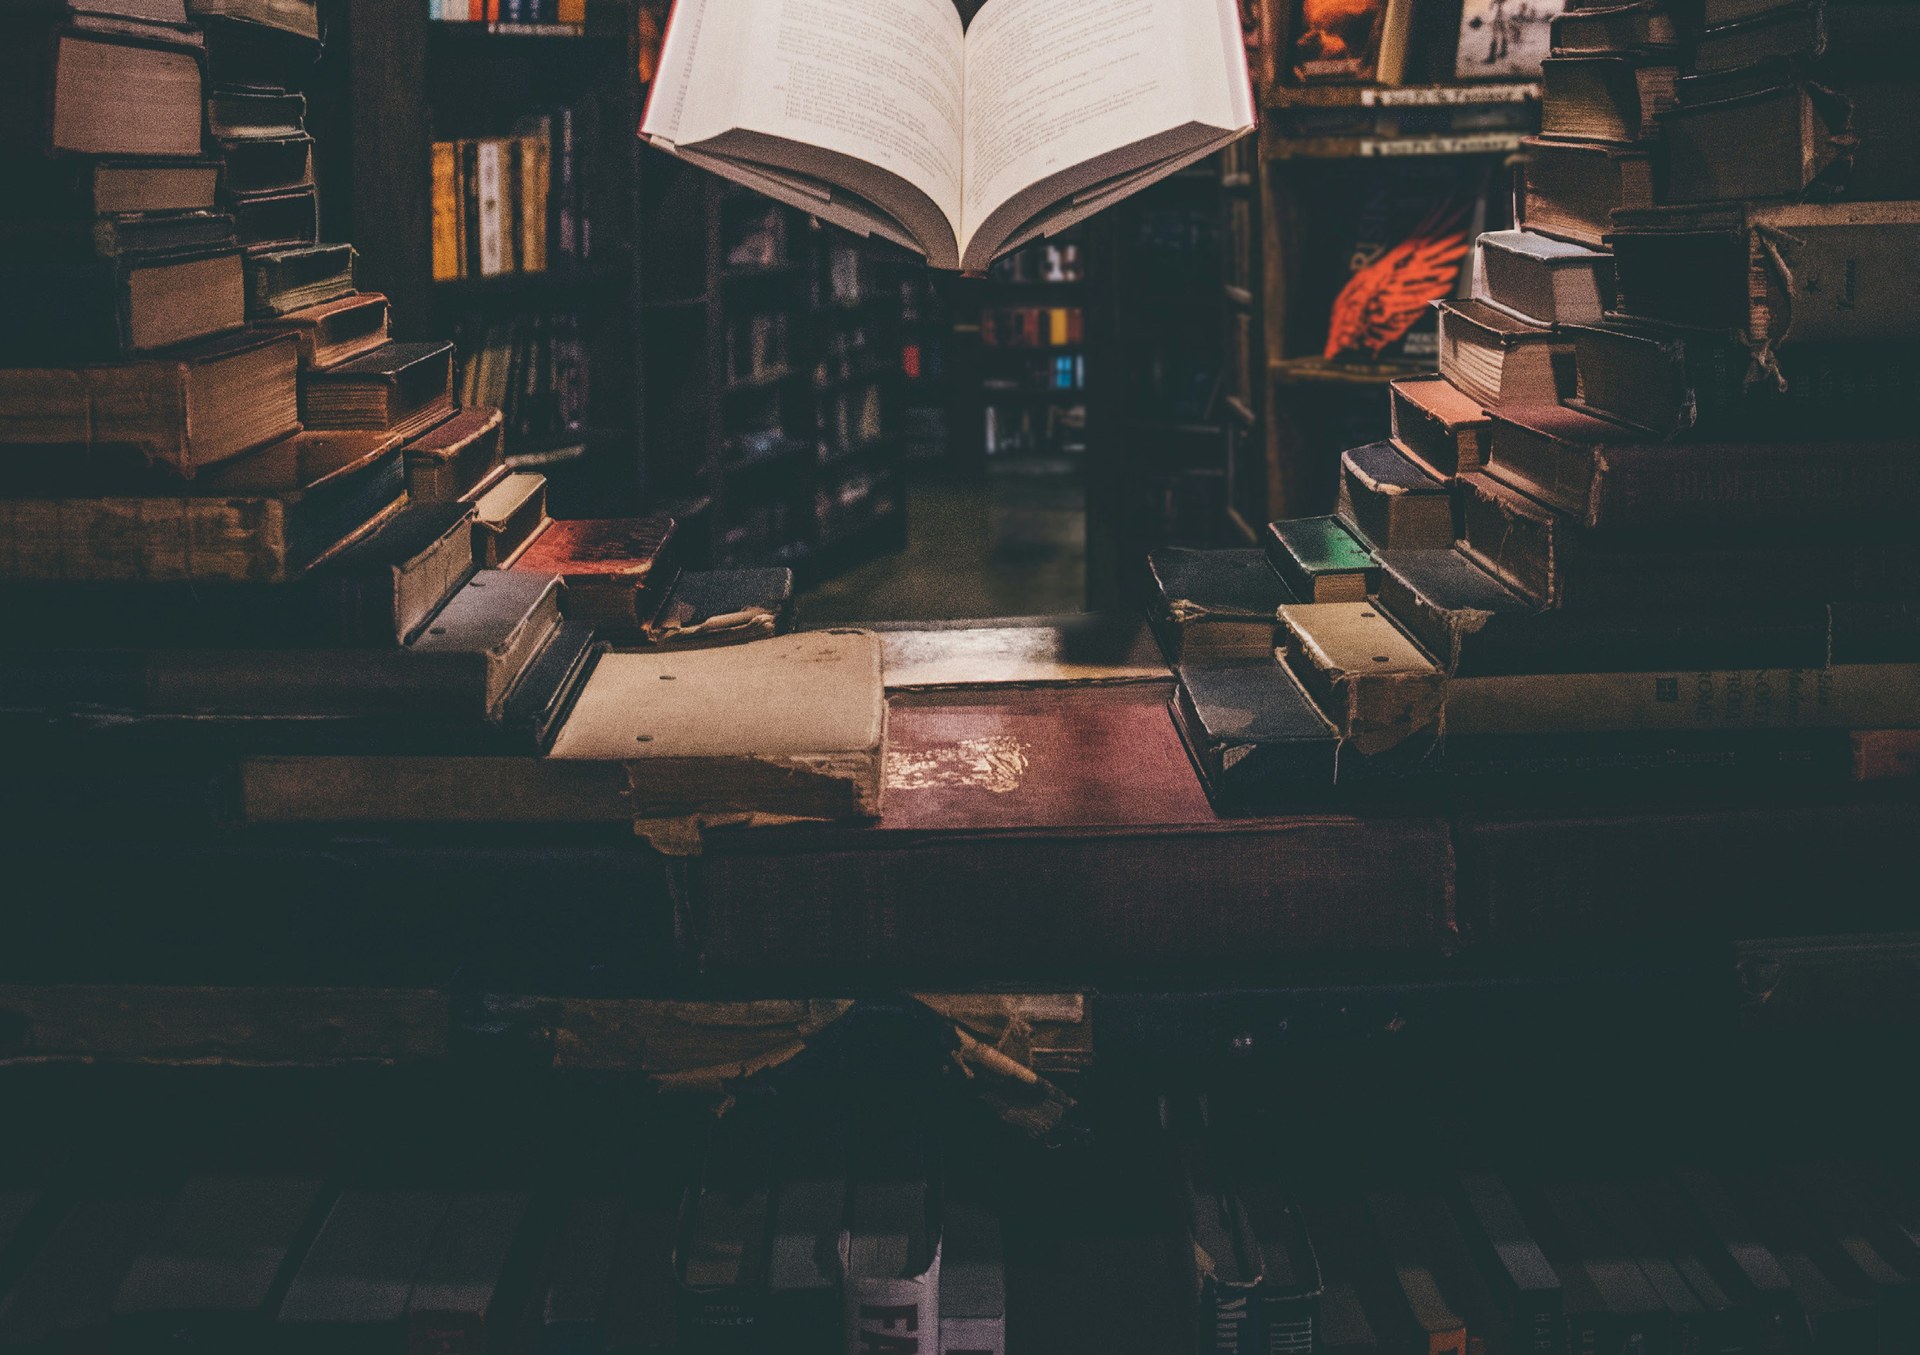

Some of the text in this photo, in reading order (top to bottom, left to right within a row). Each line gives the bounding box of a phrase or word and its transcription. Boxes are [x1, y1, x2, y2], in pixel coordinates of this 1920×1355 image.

[1349, 186, 1389, 270] RISIN
[859, 1303, 918, 1355] FA
[1270, 1317, 1313, 1354] THE
